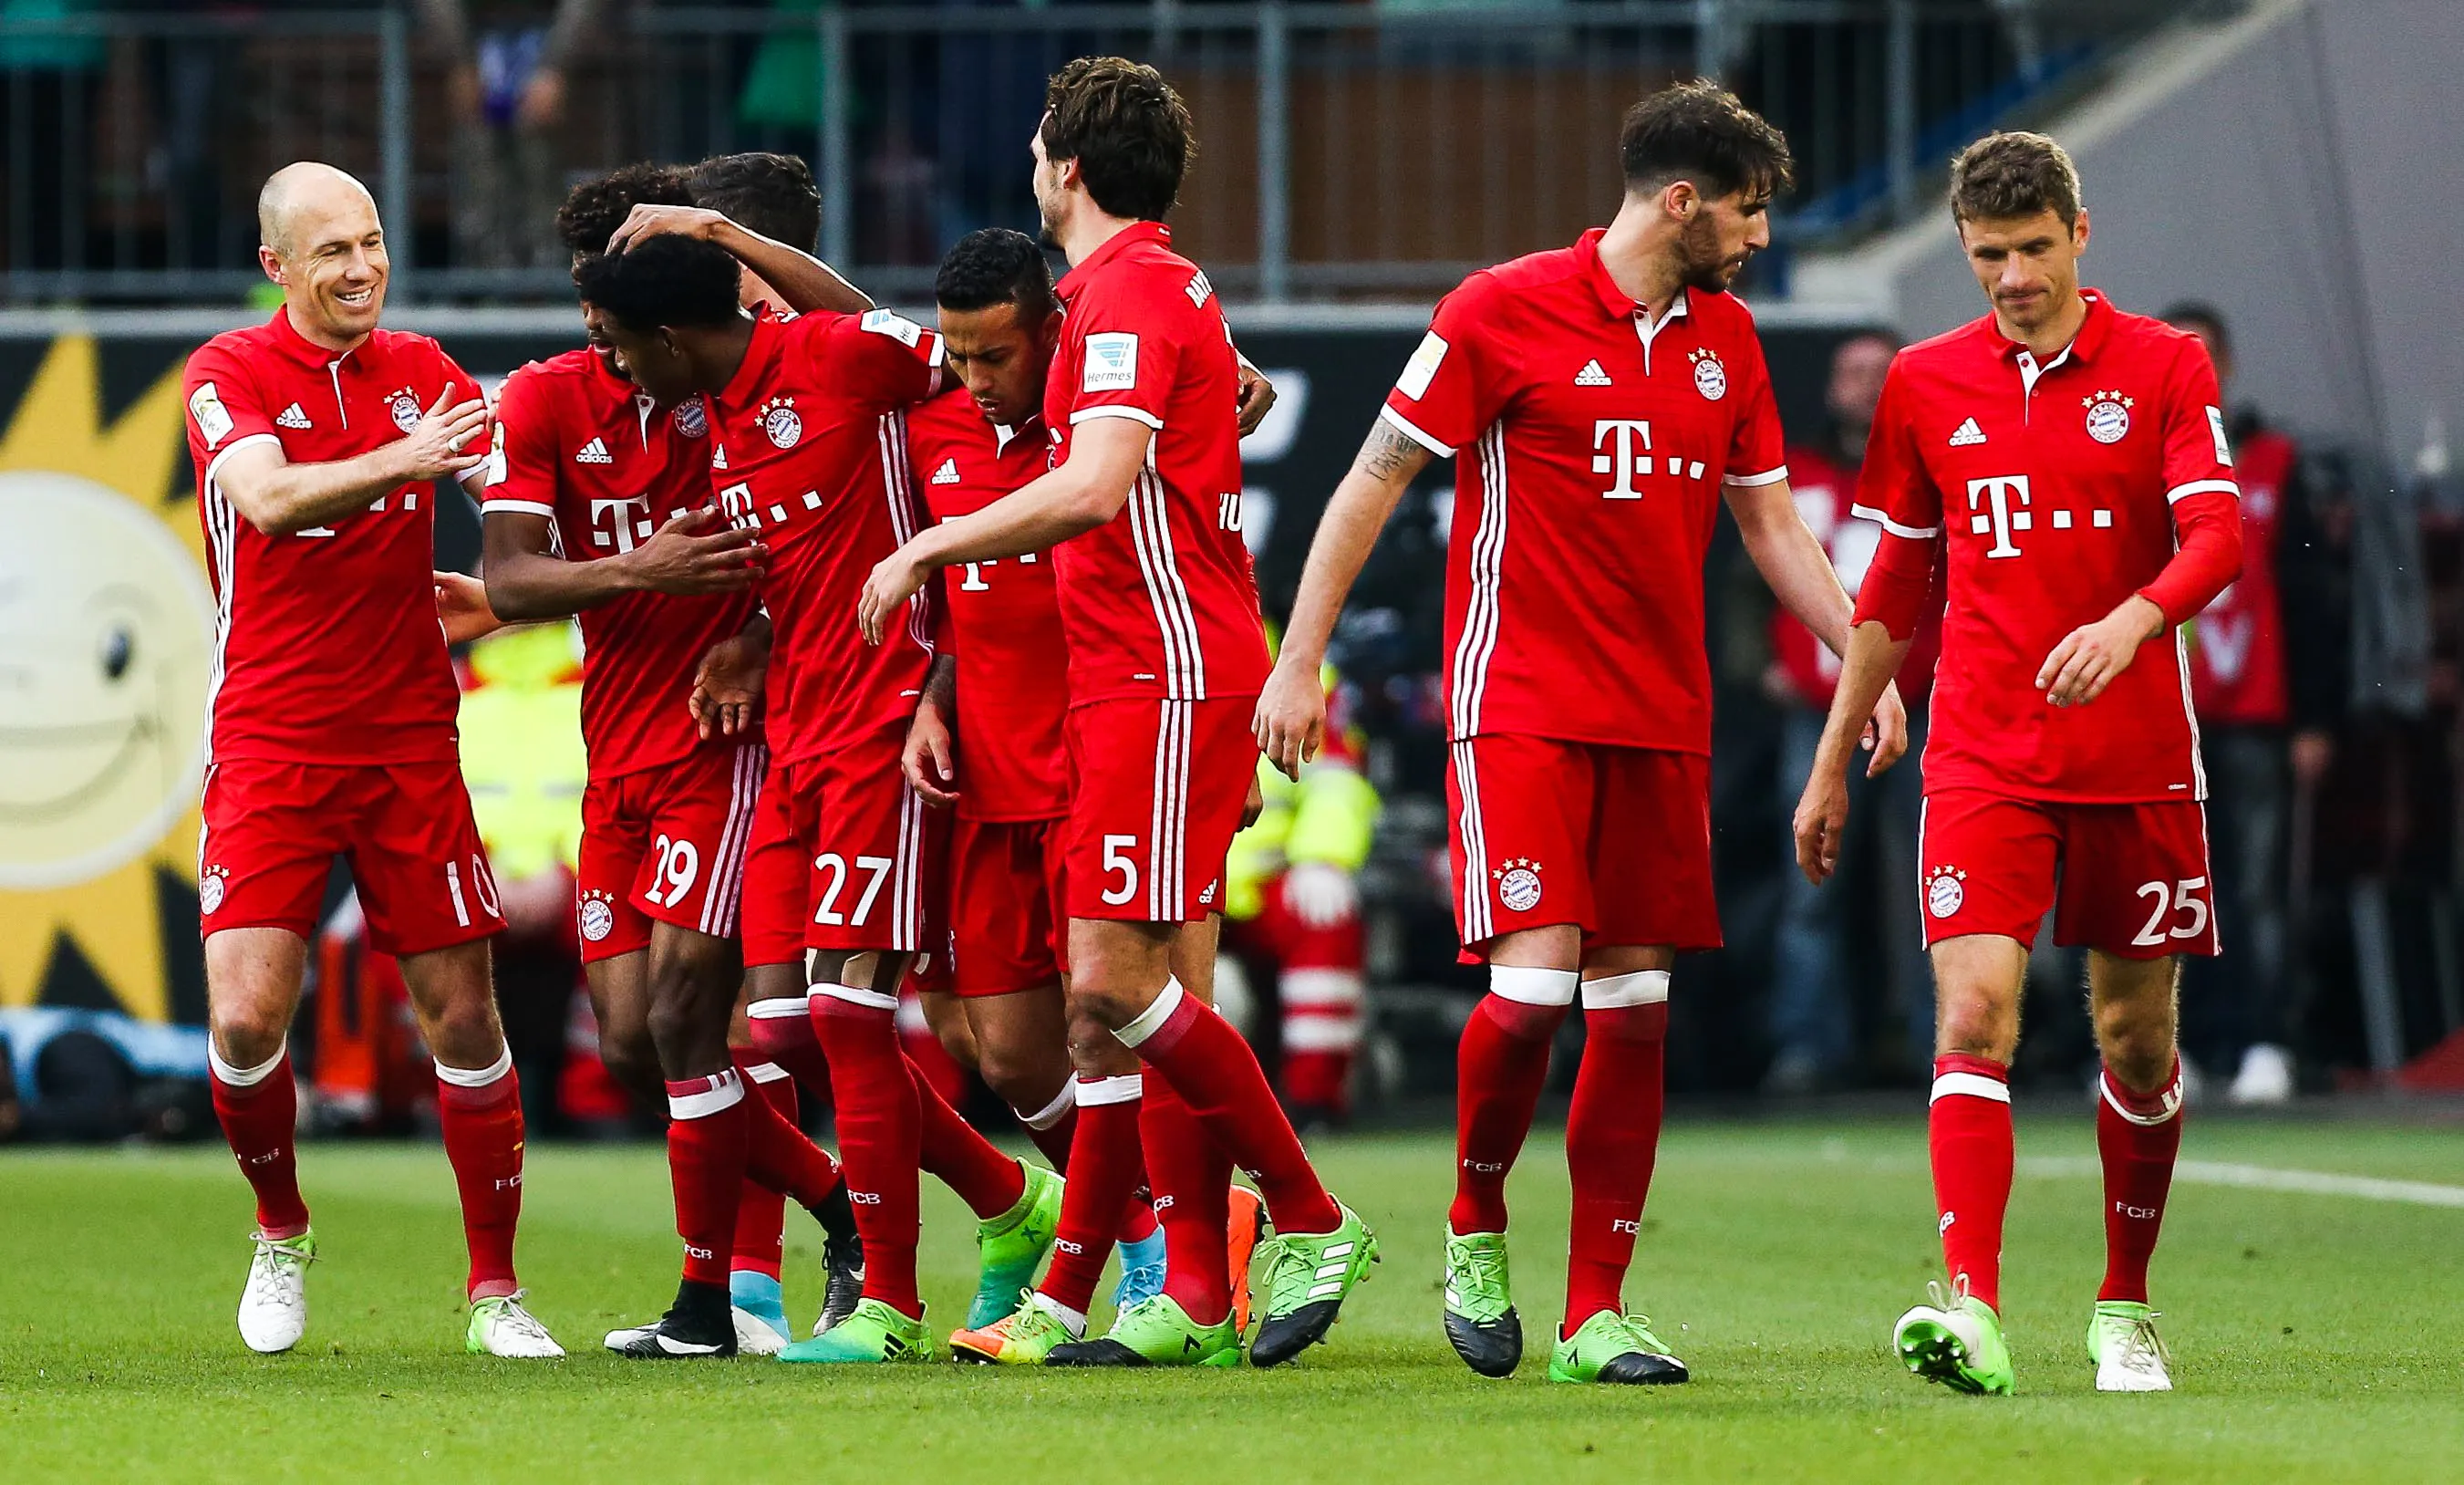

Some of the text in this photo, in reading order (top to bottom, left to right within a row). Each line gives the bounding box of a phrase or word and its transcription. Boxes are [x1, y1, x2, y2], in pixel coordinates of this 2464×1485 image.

[1087, 372, 1132, 383] Hermes
[1574, 377, 1612, 386] adidas
[276, 416, 313, 429] adidas
[1949, 434, 1986, 447] adidas
[576, 454, 612, 463] adidas
[645, 834, 699, 909] 29
[1101, 834, 1138, 905] 5
[447, 854, 500, 927] 10
[814, 853, 893, 927] 27
[2131, 876, 2208, 947] 25
[1154, 1195, 1175, 1213] CB
[2116, 1200, 2156, 1220] FCB
[684, 1242, 712, 1260] FCB
[1053, 1236, 1083, 1255] FCB
